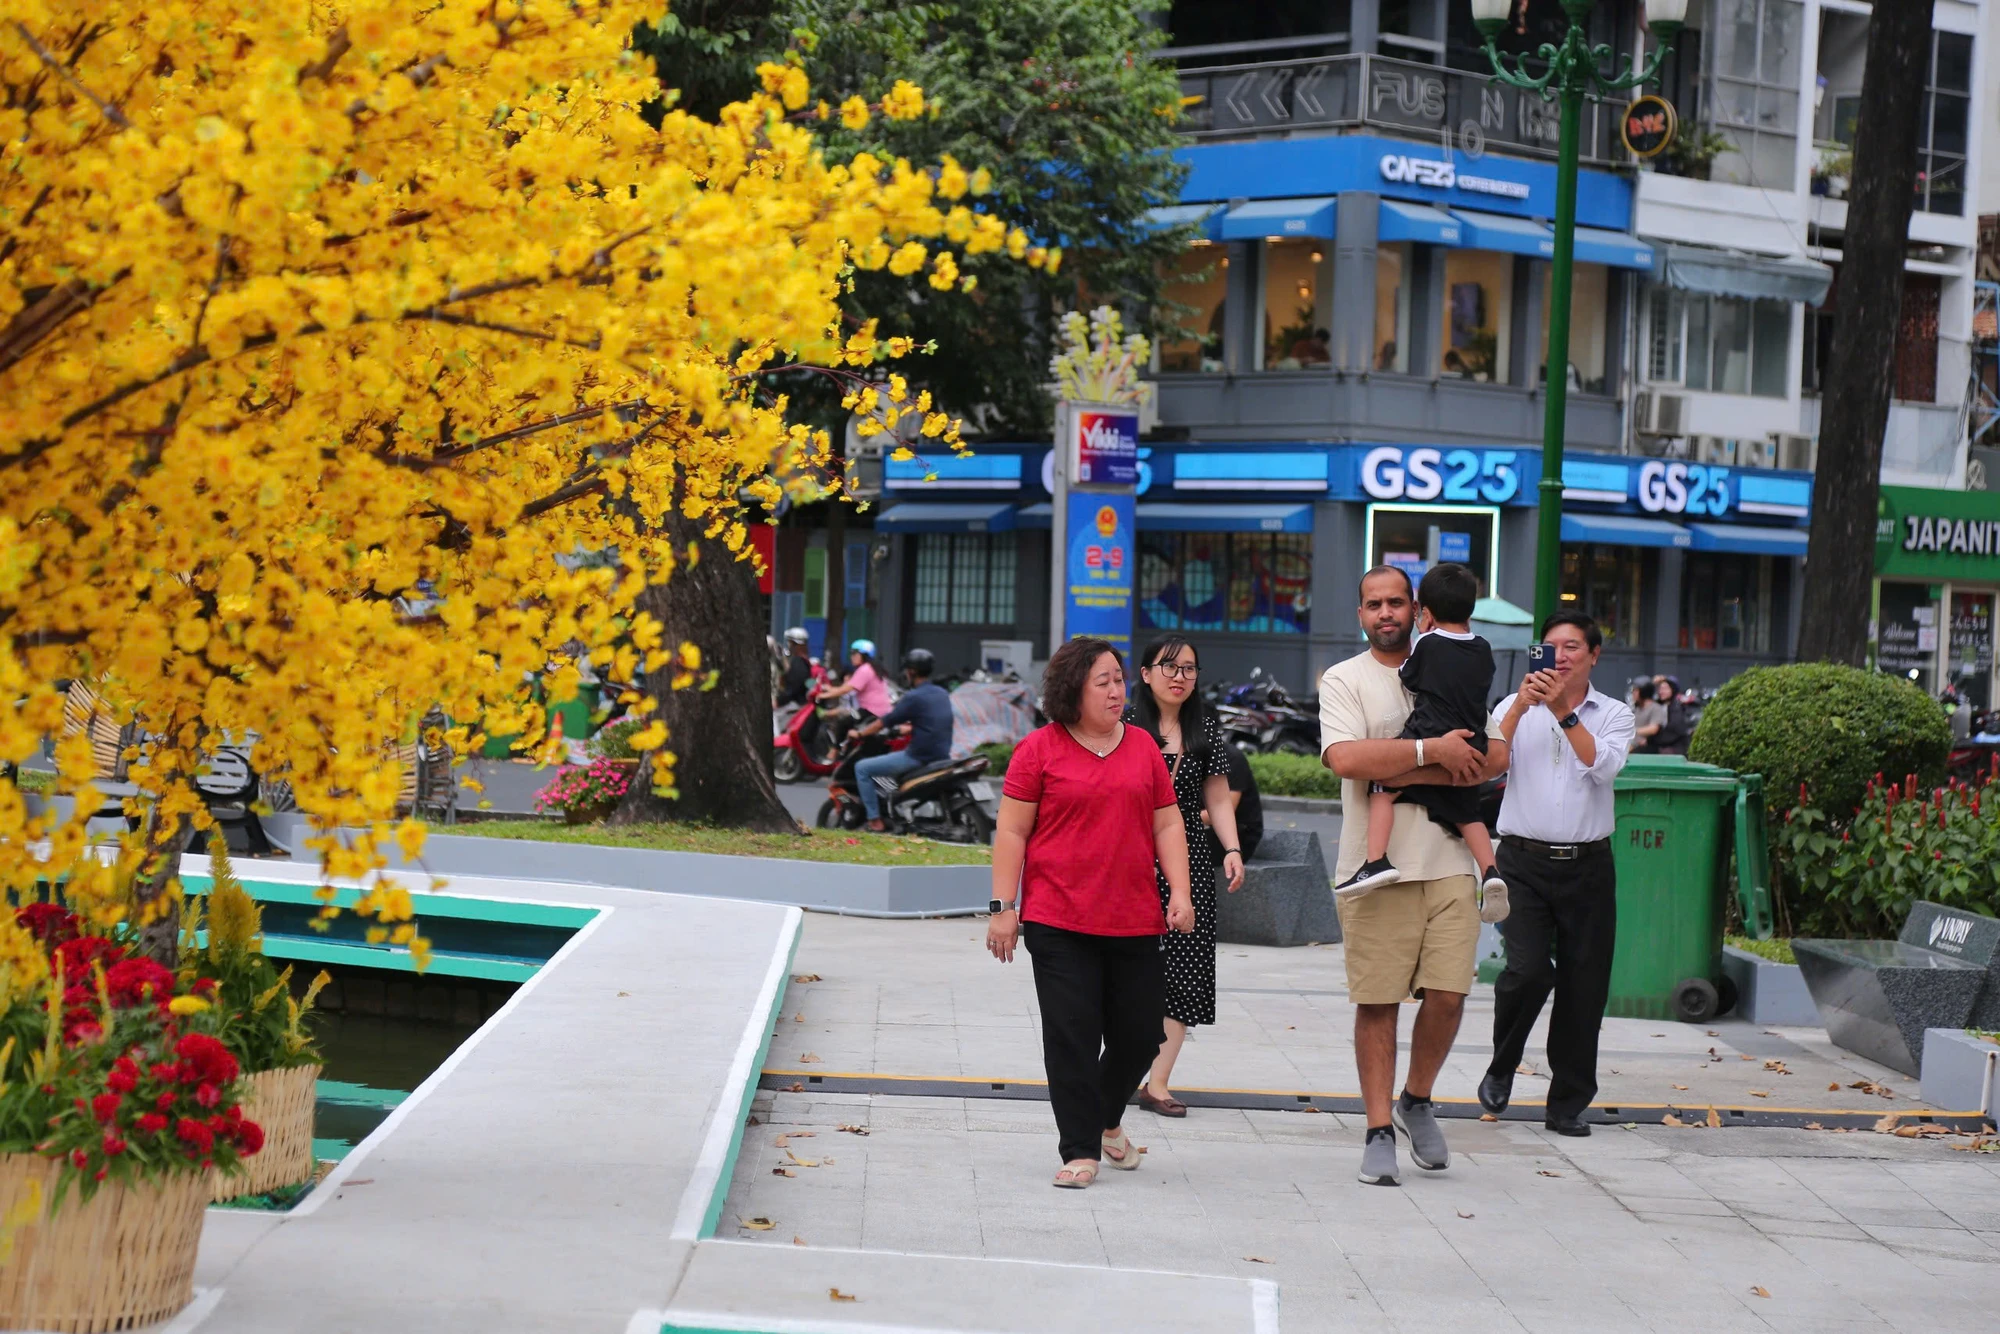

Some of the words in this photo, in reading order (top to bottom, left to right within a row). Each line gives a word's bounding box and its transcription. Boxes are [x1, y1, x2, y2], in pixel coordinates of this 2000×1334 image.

[1361, 446, 1518, 502] GS25
[1638, 460, 1729, 517] GS25
[1085, 546, 1124, 568] 2-9
[1630, 829, 1665, 851] HCR
